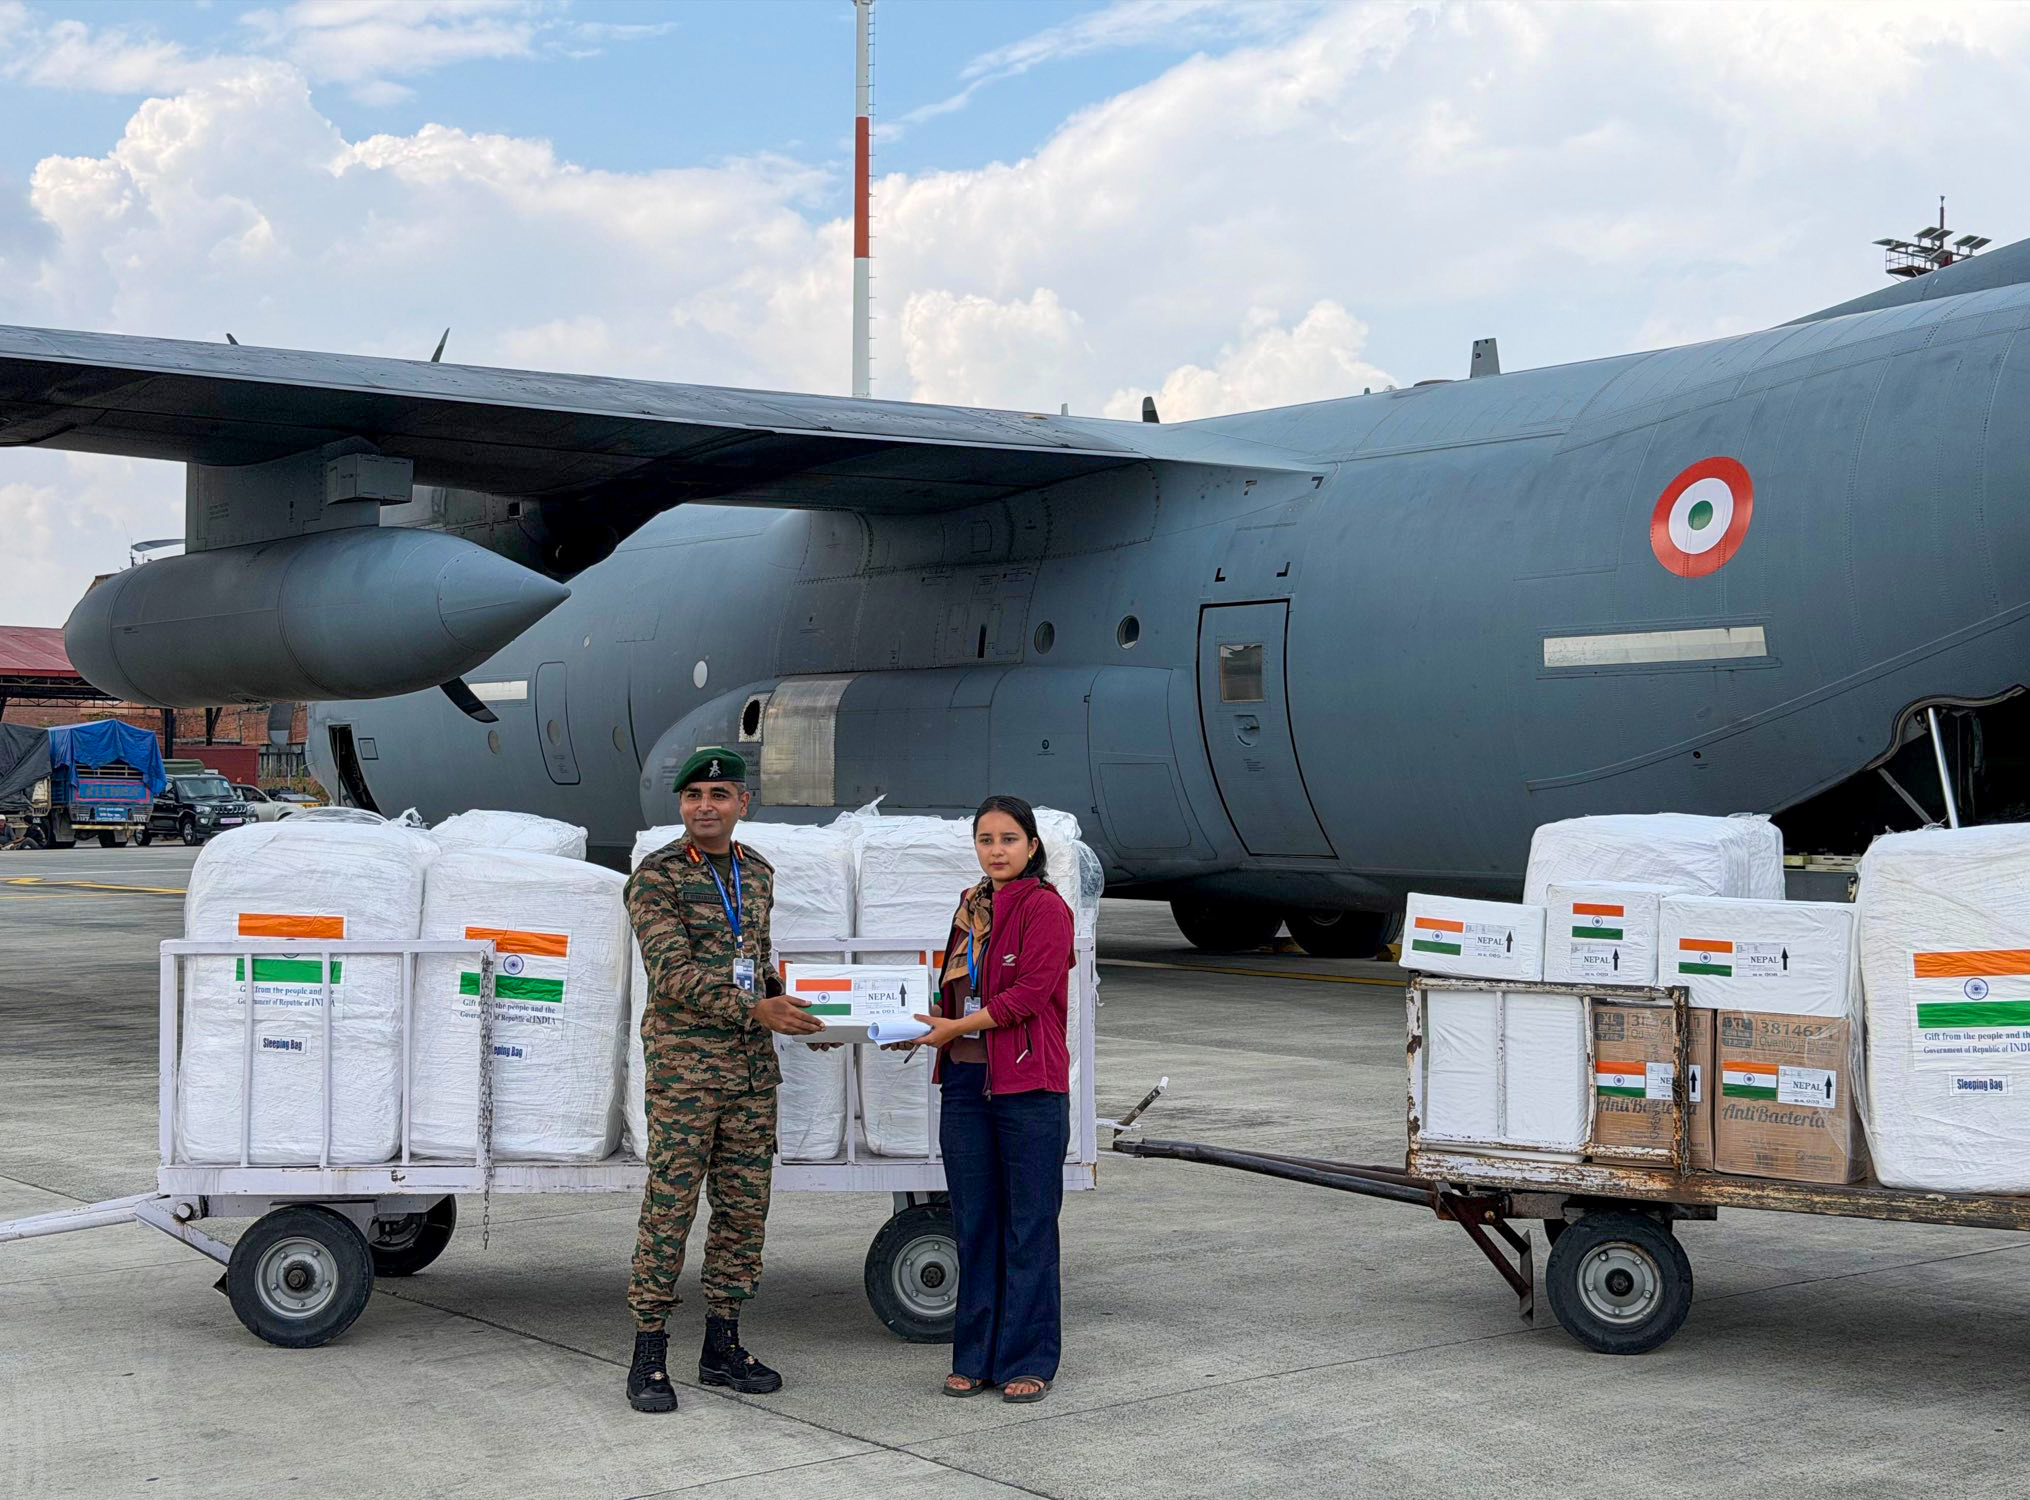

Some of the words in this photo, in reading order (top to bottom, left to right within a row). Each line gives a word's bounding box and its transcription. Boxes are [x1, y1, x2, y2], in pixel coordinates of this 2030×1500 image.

[1477, 936, 1504, 946] NEPAL
[1584, 955, 1611, 964] NEPAL
[1750, 955, 1779, 964] NEPAL
[255, 985, 272, 994] from
[284, 987, 308, 996] people
[868, 992, 898, 1001] NEPAL
[272, 998, 279, 1006] of
[279, 998, 303, 1008] Republic
[312, 998, 335, 1007] INA
[462, 999, 476, 1007] Gift
[507, 1003, 530, 1012] people
[531, 1005, 543, 1013] and
[545, 1006, 556, 1014] the
[501, 1014, 525, 1023] Republic
[533, 1015, 556, 1025] INDIA
[1924, 1032, 1940, 1041] Gift
[1942, 1032, 1961, 1041] from
[1963, 1032, 1975, 1040] the
[1977, 1032, 2003, 1042] people
[2005, 1031, 2020, 1039] and
[2022, 1030, 2030, 1039] th
[263, 1037, 290, 1051] Sleeping
[290, 1039, 303, 1051] Bag
[1923, 1046, 1963, 1054] Government
[1972, 1045, 2001, 1055] Republic
[2001, 1045, 2009, 1053] of
[2010, 1042, 2030, 1052] INDI
[511, 1046, 523, 1058] Bag
[1792, 1080, 1823, 1092] NEPAL
[1957, 1078, 1988, 1091] Sleeping
[1989, 1078, 2003, 1091] Bag
